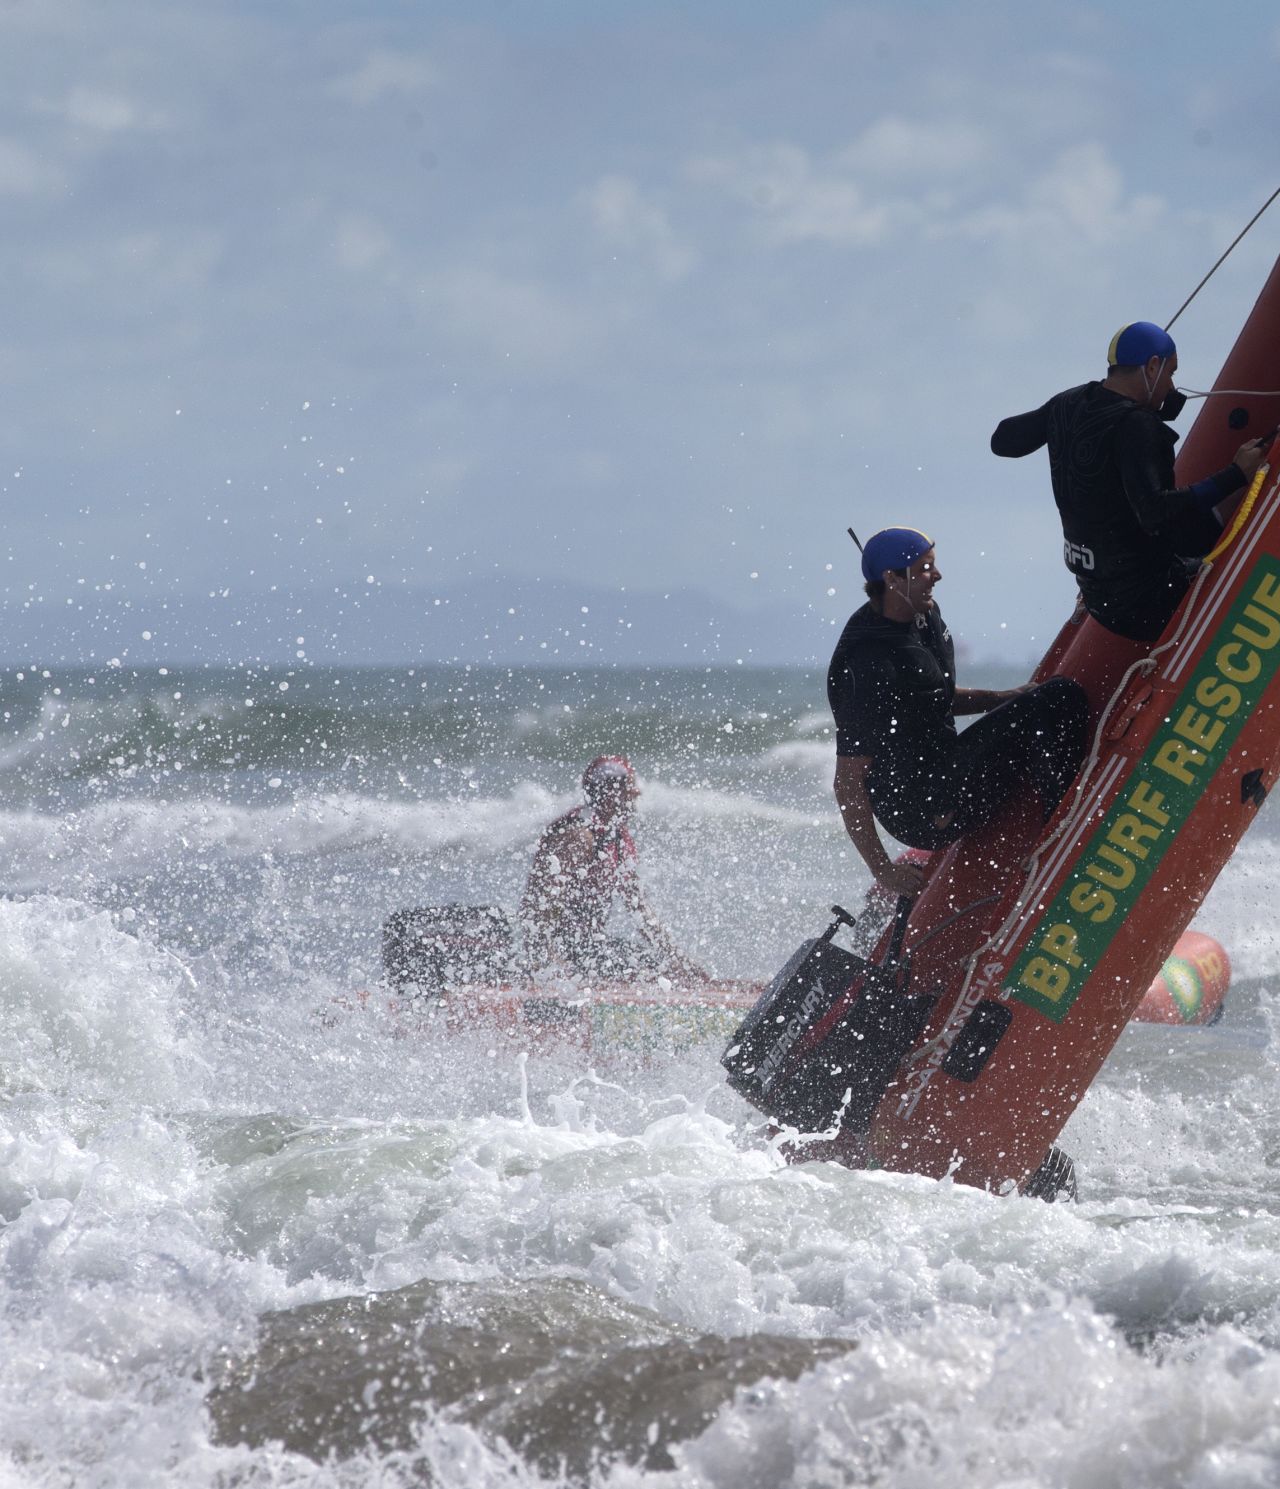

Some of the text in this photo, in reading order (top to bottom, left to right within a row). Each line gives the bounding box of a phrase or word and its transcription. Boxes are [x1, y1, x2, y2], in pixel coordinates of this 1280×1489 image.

[1019, 923, 1083, 1002] BP
[1069, 781, 1172, 923] SURF
[753, 976, 826, 1094] MERCURY
